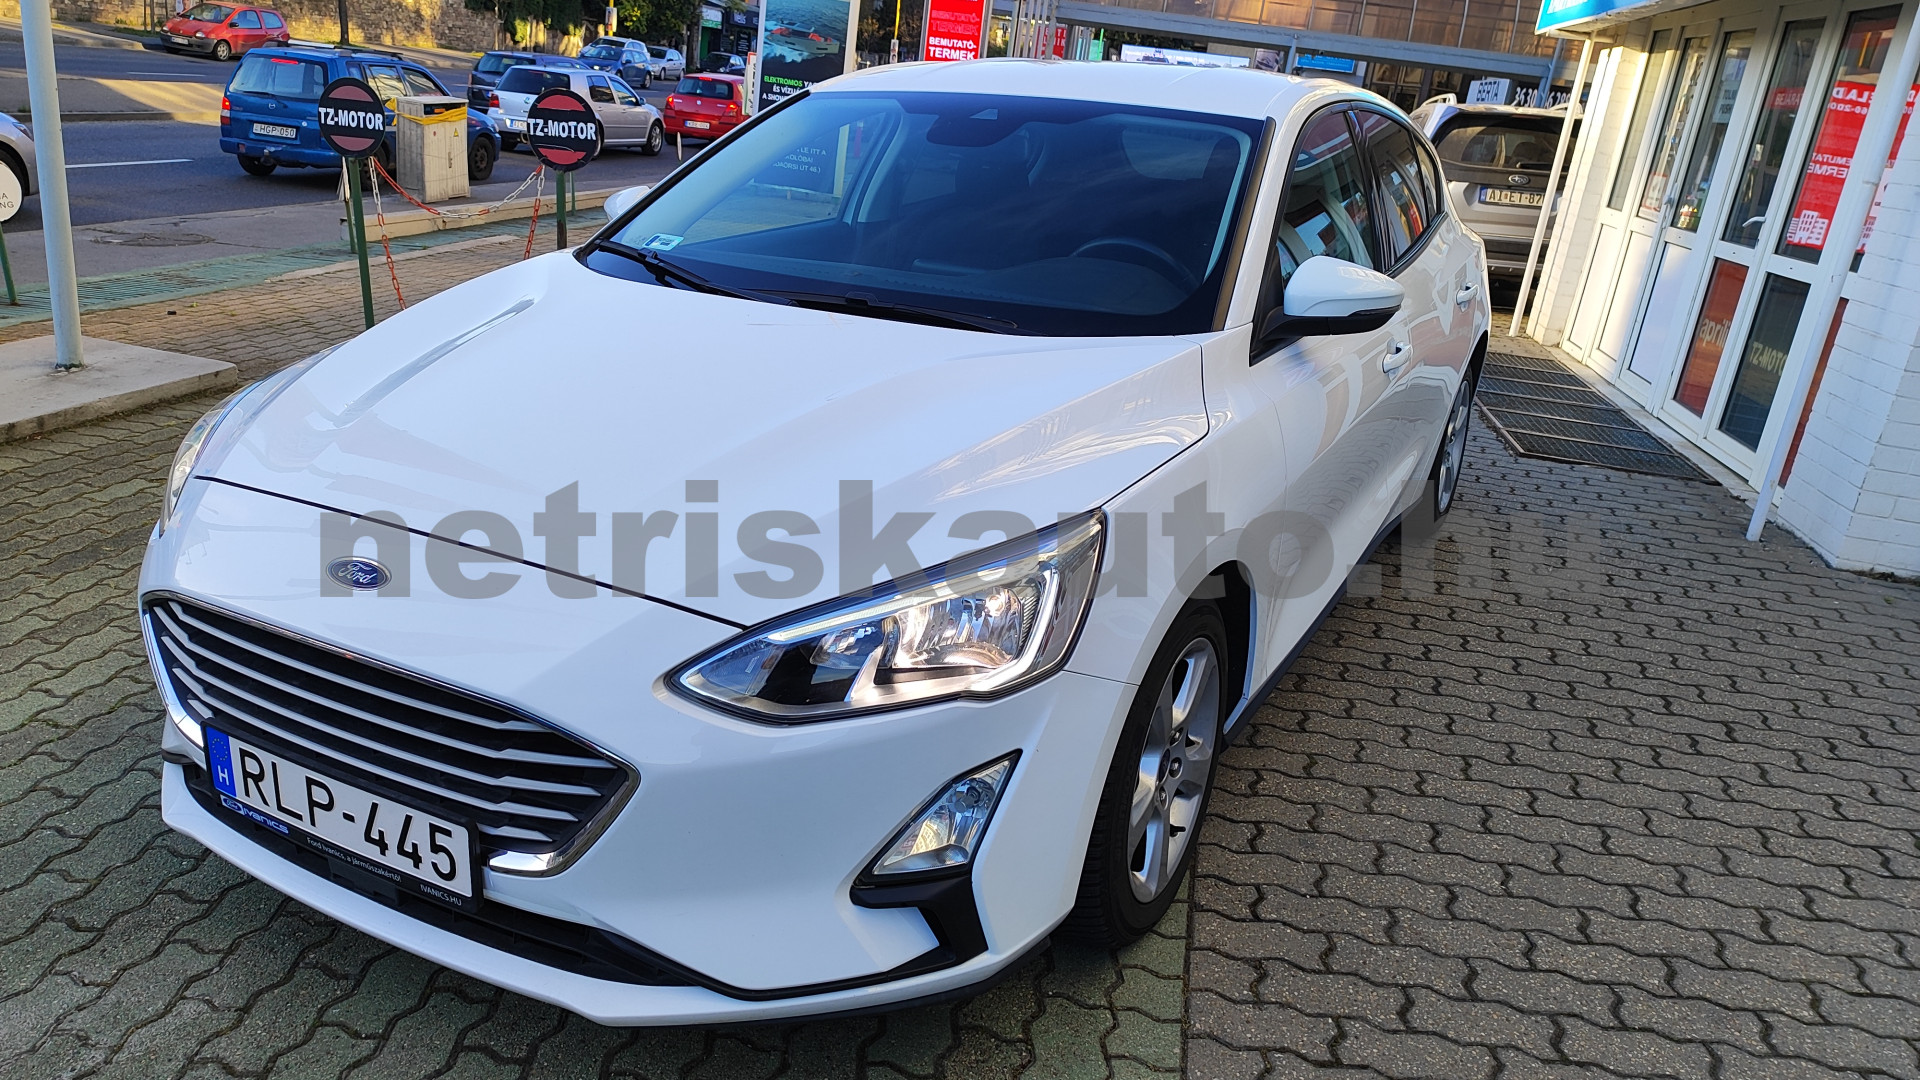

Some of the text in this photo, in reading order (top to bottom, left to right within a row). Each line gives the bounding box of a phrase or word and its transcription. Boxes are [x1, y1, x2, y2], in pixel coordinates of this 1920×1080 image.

[931, 20, 979, 36] TERMEK
[928, 46, 976, 60] TERMEK
[929, 36, 977, 49] BEMUTATÓ-
[763, 76, 803, 87] ELEKTROMOS
[773, 84, 780, 92] ÉS
[1476, 80, 1500, 102] BERTA
[319, 107, 383, 130] TZ-MOTOR
[528, 118, 596, 140] TZ-MOTOR
[260, 126, 295, 137] HGP-050
[1508, 191, 1546, 206] ET-87
[338, 562, 377, 584] Ford
[217, 765, 230, 786] H
[239, 747, 457, 882] RLP-445
[307, 837, 322, 849] Ford
[323, 843, 347, 860] Ivanics,
[420, 884, 462, 906] IVANICS.HU
